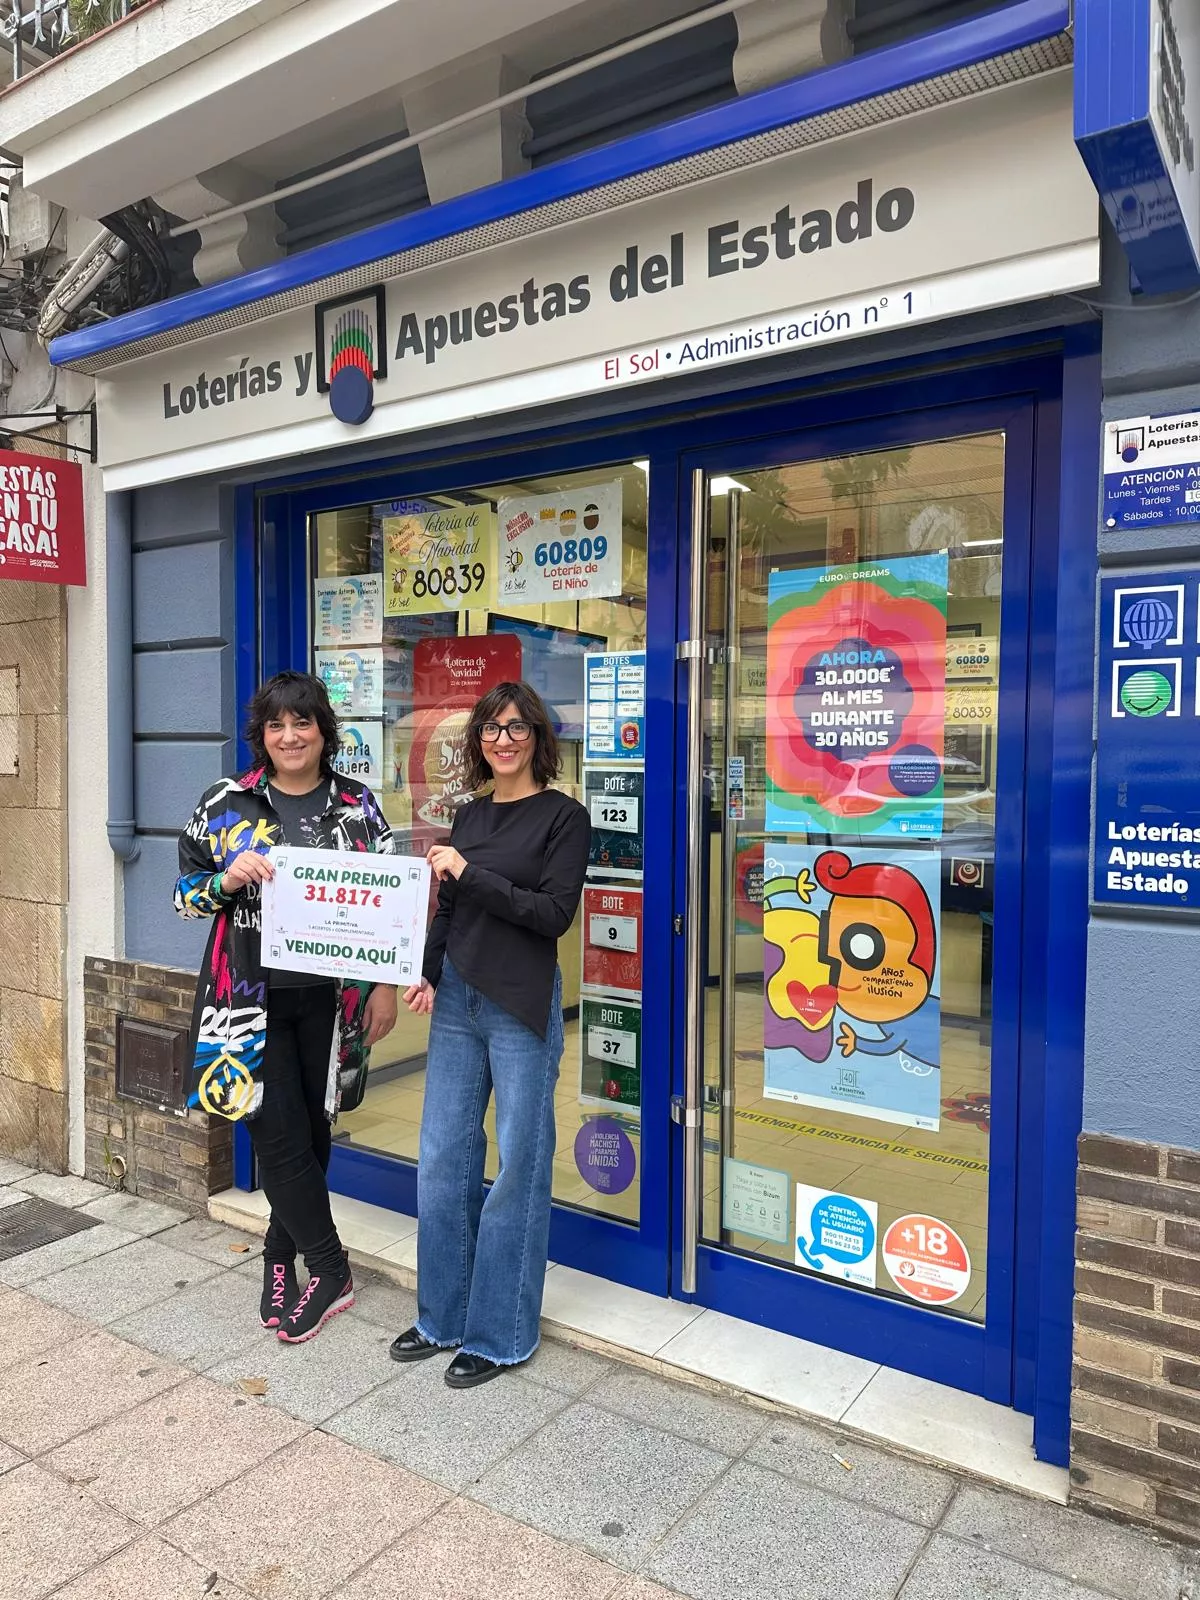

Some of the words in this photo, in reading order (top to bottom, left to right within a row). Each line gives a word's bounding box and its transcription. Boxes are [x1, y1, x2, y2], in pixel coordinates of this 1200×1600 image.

[163, 355, 283, 419] Loterías
[294, 351, 313, 396] y
[395, 273, 591, 363] Apuestas
[609, 233, 684, 303] del
[707, 178, 915, 278] Estado
[604, 356, 620, 381] El
[629, 349, 660, 376] Sol
[678, 309, 851, 365] Administración
[903, 291, 914, 316] 1
[1121, 468, 1184, 487] ATENCIÓN
[1108, 490, 1136, 499] Lunes
[1144, 484, 1180, 495] Viernes
[1141, 496, 1171, 507] Tardes
[0, 492, 20, 521] N
[26, 494, 58, 531] TU
[1123, 510, 1164, 522] Sábados
[465, 512, 479, 528] de
[507, 517, 534, 542] EXCLUSIVO
[418, 538, 480, 565] Navidad
[535, 535, 608, 567] 60809
[543, 564, 582, 578] Lotería
[585, 562, 598, 573] de
[412, 562, 486, 598] 80839
[552, 579, 562, 590] El
[565, 578, 589, 590] Niño
[445, 657, 475, 669] Lotería
[476, 657, 486, 669] de
[603, 656, 630, 666] BOTES
[819, 649, 887, 667] AHORA
[956, 655, 990, 665] 60809
[451, 667, 482, 677] Navidad
[821, 690, 845, 705] AL
[848, 689, 883, 704] MES
[810, 709, 895, 726] DURANTE
[953, 706, 992, 718] 80839
[815, 732, 838, 746] 30
[840, 727, 889, 747] AÑOS
[340, 743, 370, 757] tería
[335, 761, 370, 775] iajera
[604, 777, 626, 791] BOTE
[601, 809, 627, 822] 123
[1108, 846, 1200, 871] Apuesta
[293, 866, 339, 884] GRAN
[340, 871, 401, 888] PREMIO
[1107, 871, 1189, 894] Estado
[304, 884, 383, 908] 31.817€
[602, 895, 624, 909] BOTE
[332, 920, 358, 928] PRIMITIVA
[608, 927, 617, 940] 9
[285, 938, 354, 959] VENDIDO
[356, 946, 397, 966] AQUÍ
[881, 967, 904, 978] AÑOS
[601, 1008, 623, 1024] BOTE
[602, 1040, 621, 1055] 37
[839, 1087, 865, 1095] PRIMITIVA
[589, 1139, 620, 1149] MACHISTA
[798, 1125, 817, 1134] LA
[816, 1129, 891, 1151] DISTANCIA
[891, 1146, 911, 1156] DE
[912, 1150, 990, 1173] SEGURIDA
[588, 1154, 620, 1168] UNIDAS
[828, 1205, 857, 1217] CENTRO
[830, 1213, 867, 1227] ATENCIÓN
[832, 1220, 864, 1233] USUARIO
[901, 1224, 949, 1256] +18
[271, 1264, 286, 1309] DKNY
[288, 1276, 321, 1325] DKNY
